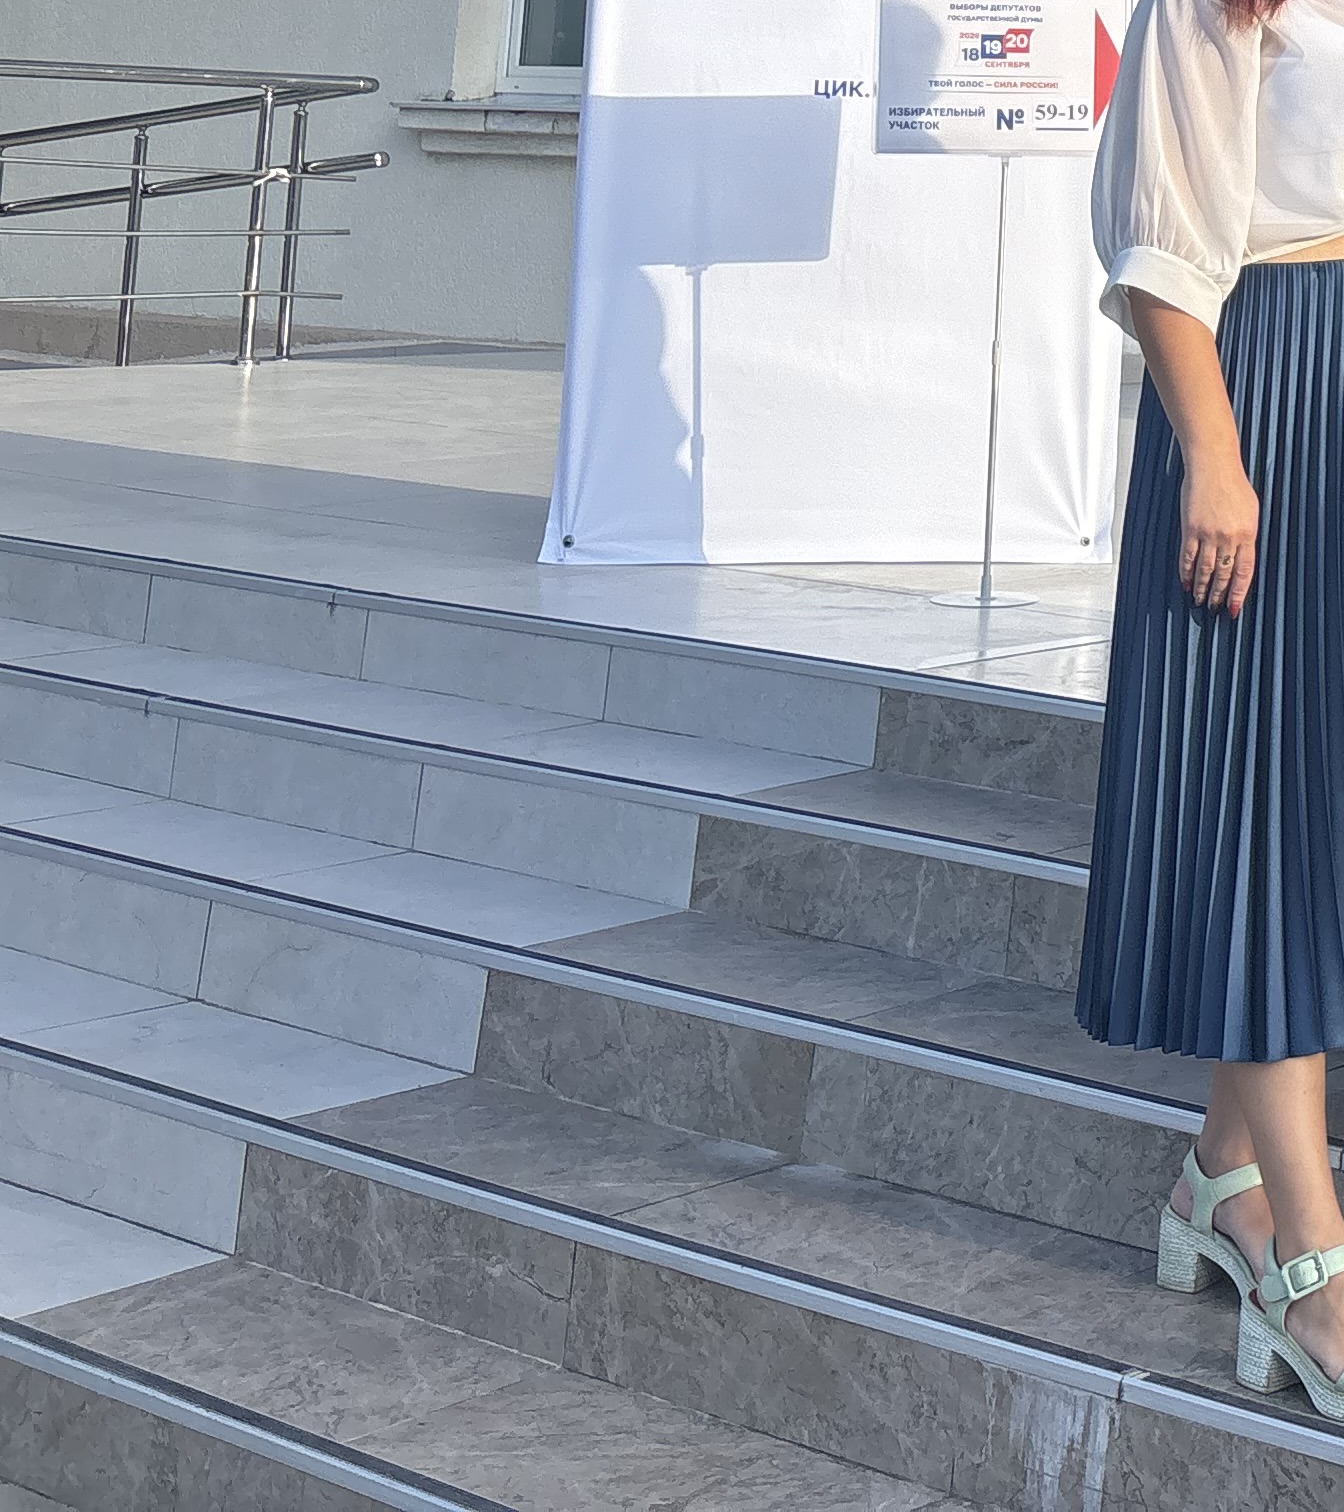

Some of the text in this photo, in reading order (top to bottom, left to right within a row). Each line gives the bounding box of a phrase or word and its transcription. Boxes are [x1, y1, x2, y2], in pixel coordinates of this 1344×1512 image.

[949, 3, 1042, 12] ВЫБОРЫ ДЕПУТАТОВ
[1005, 33, 1029, 48] 20
[983, 40, 1002, 55] 19
[961, 47, 980, 62] 18
[984, 60, 1031, 68] СЕНТЯБРЯ
[928, 79, 953, 88] ТВОЙ
[954, 80, 984, 88] ГОЛОС
[888, 105, 986, 118] ИЗБИРАТЕЛЬНЫЙ
[1034, 103, 1089, 121] 59-19
[888, 120, 940, 131] УЧАСТОК
